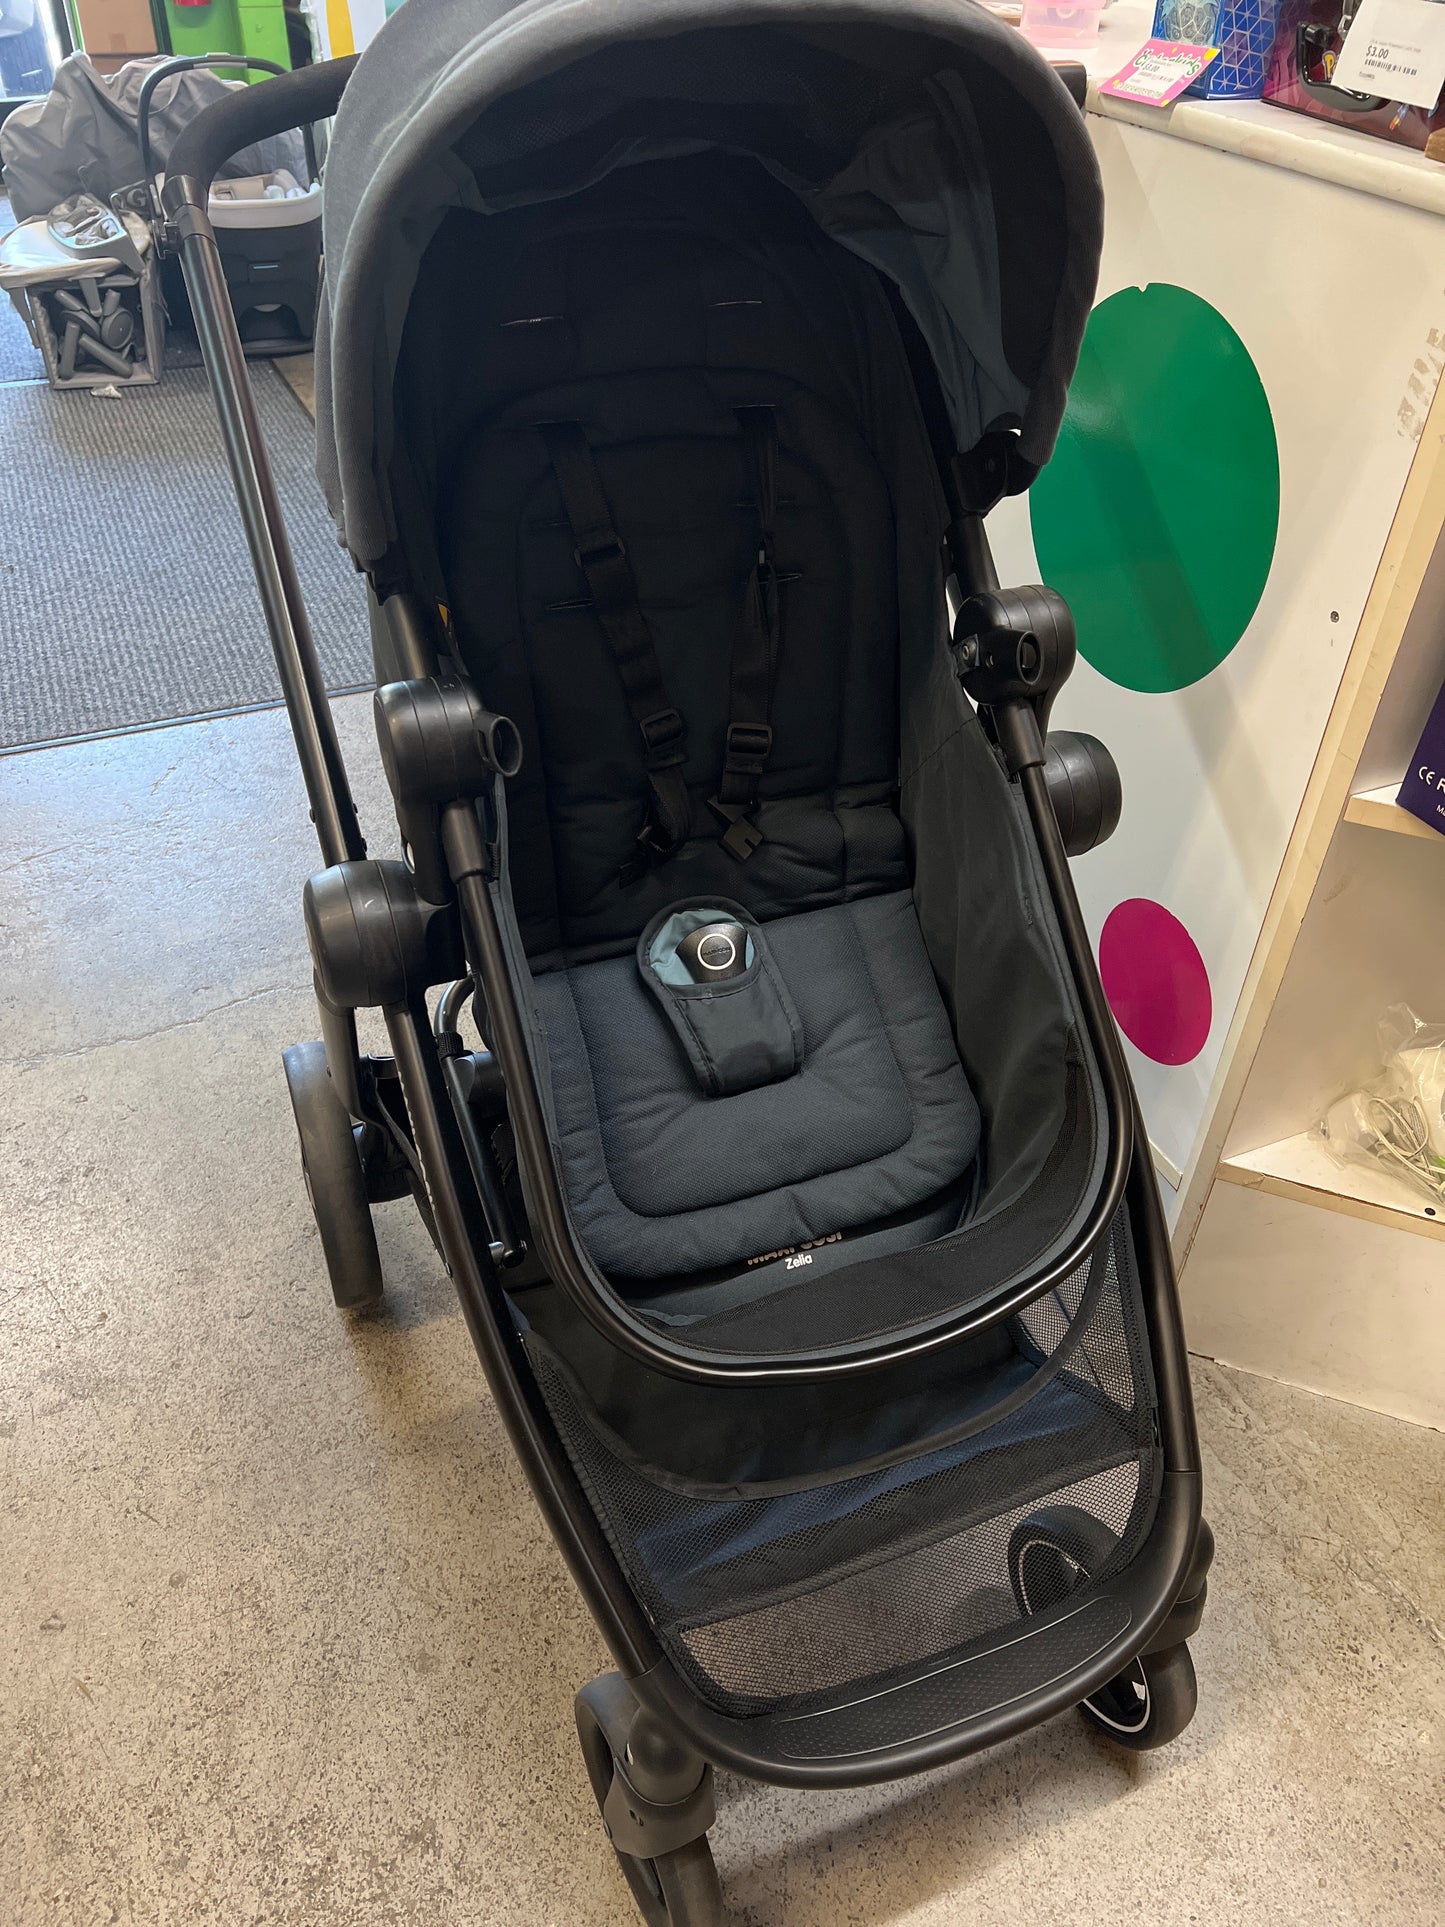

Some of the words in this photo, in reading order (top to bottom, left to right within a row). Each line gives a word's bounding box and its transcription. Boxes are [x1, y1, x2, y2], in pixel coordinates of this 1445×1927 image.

[1365, 45, 1389, 60] $3.00
[1418, 766, 1436, 786] CE
[784, 1253, 813, 1270] Zelia
